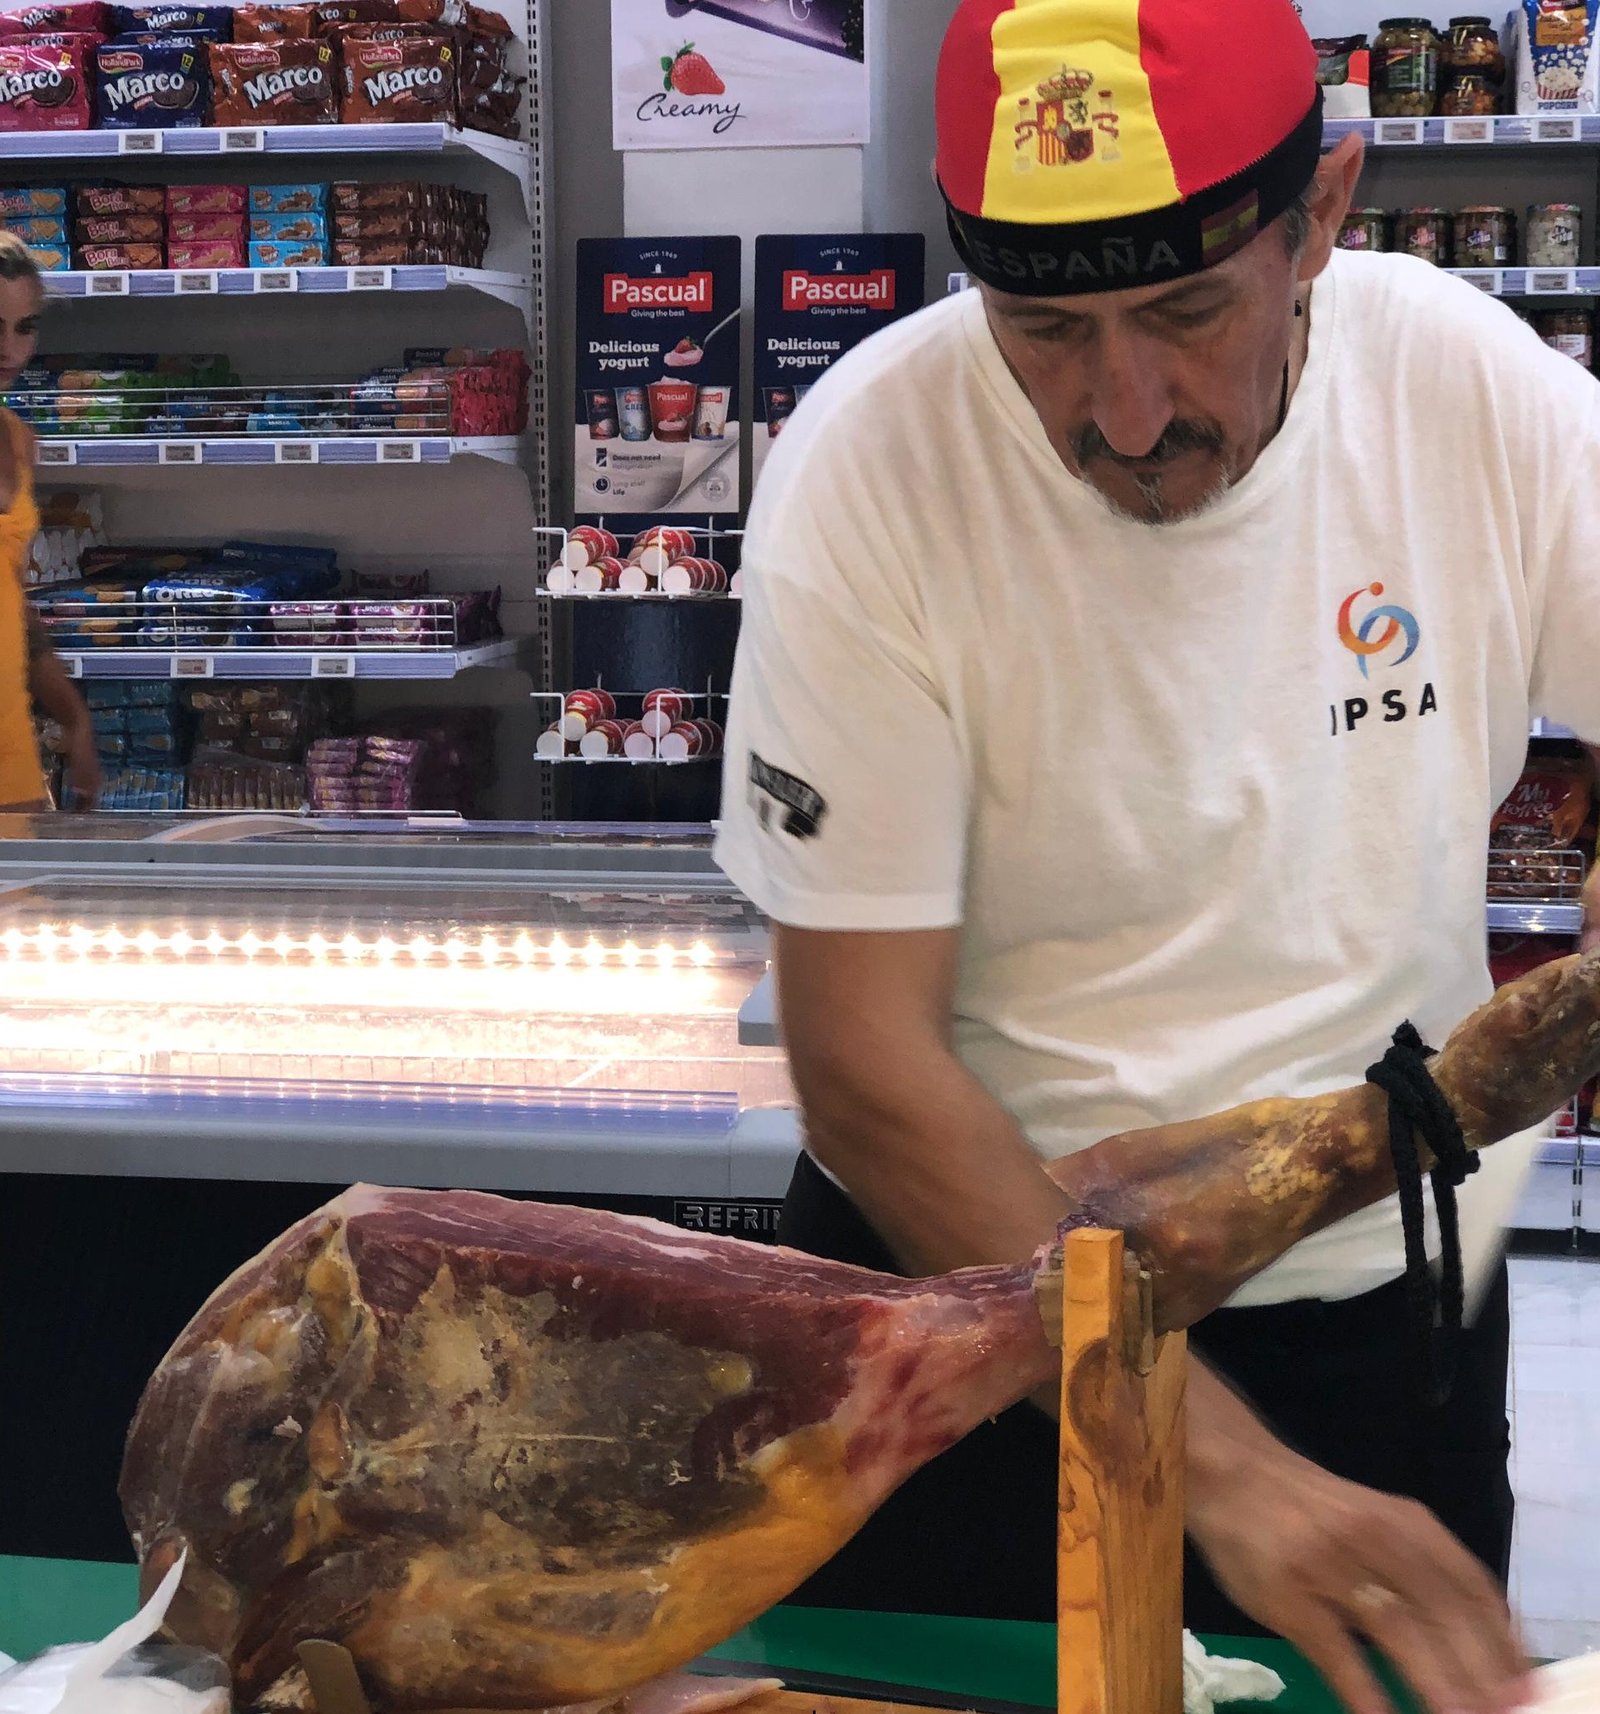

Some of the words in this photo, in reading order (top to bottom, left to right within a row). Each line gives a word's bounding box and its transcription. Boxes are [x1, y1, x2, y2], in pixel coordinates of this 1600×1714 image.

[145, 10, 187, 30] Marco
[320, 48, 329, 60] 12
[441, 48, 451, 60] 12
[183, 55, 193, 67] 12
[104, 73, 184, 111] Marco
[243, 67, 322, 109] Marco
[364, 66, 442, 107] Marco
[1537, 101, 1578, 110] POPCORN
[636, 93, 746, 133] Creamy
[639, 251, 659, 260] SINCE
[819, 248, 841, 257] SINCE
[974, 236, 1181, 280] ESPAÑA
[611, 278, 705, 303] Pascual
[790, 276, 887, 300] Pascual
[631, 309, 655, 319] Giving
[655, 309, 668, 317] the
[669, 309, 684, 317] best
[811, 307, 835, 316] Giving
[589, 340, 660, 353] Delicious
[767, 338, 840, 351] Delicious
[598, 356, 650, 371] yogurt
[777, 354, 830, 368] yogurt
[656, 392, 688, 401] Pascual
[1330, 682, 1437, 736] IPSA
